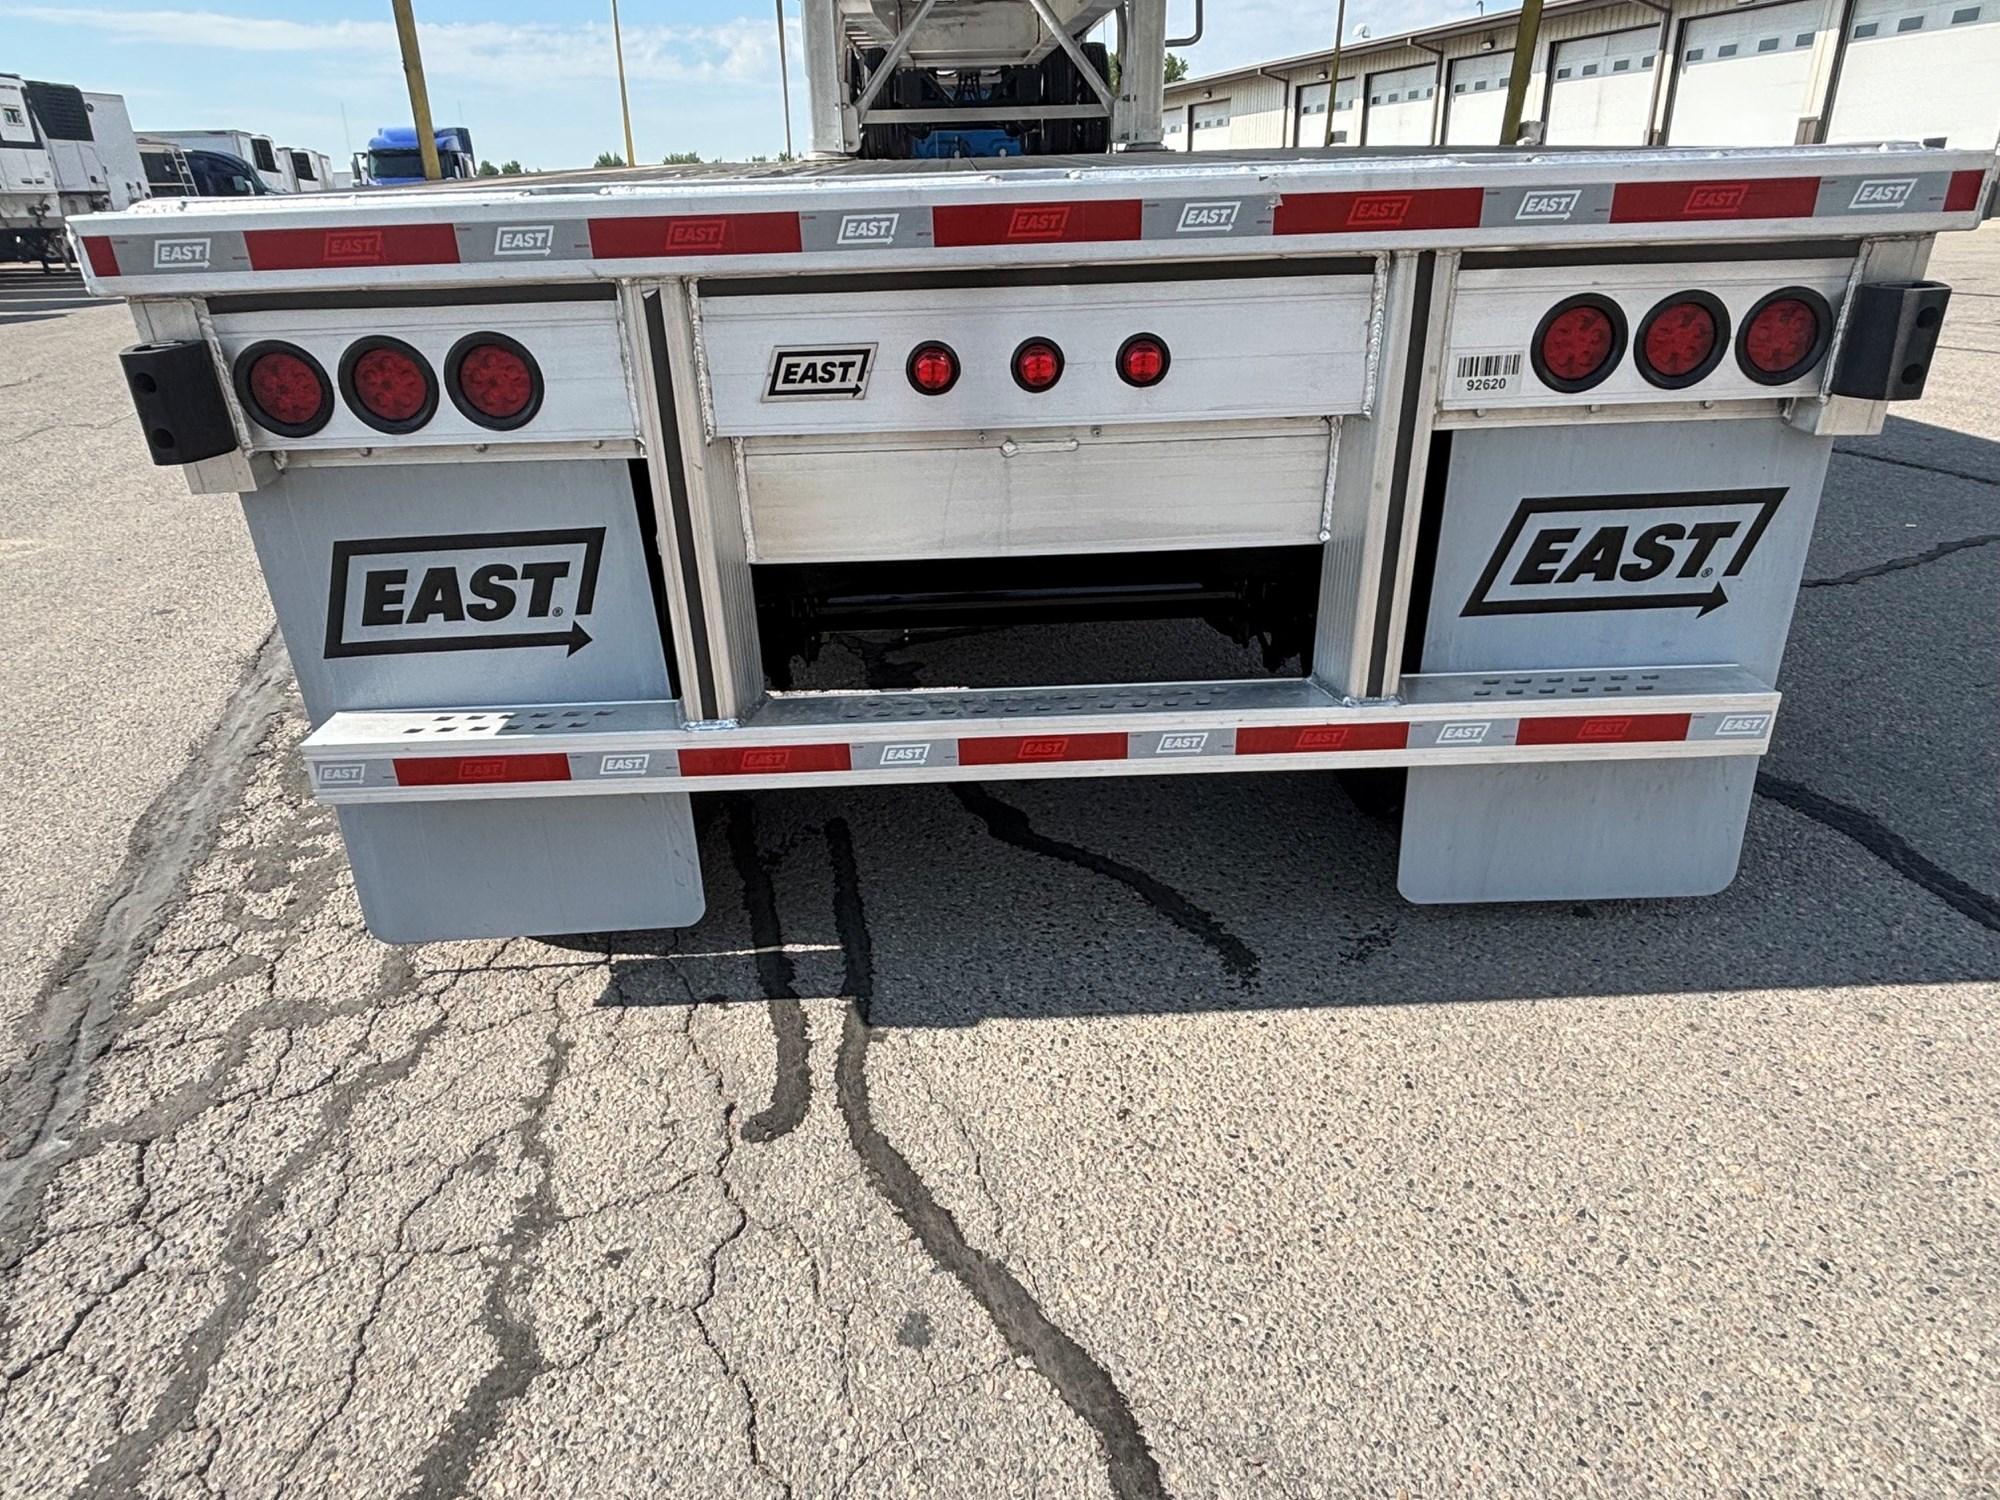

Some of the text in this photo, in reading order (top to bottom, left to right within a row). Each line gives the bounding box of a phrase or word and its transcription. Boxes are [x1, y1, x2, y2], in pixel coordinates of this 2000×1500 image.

[1860, 186, 1906, 200] EAST
[1526, 197, 1572, 212] EAST
[1186, 209, 1231, 224] EAST
[845, 222, 889, 236] EAST
[502, 232, 546, 247] EAST
[161, 246, 203, 260] EAST
[782, 362, 856, 384] EAST
[1467, 378, 1506, 391] 92620
[1723, 720, 1760, 730] EAST
[1443, 728, 1481, 738] EAST
[1164, 738, 1199, 748] EAST
[887, 749, 924, 759] EAST
[606, 759, 642, 770] EAST
[323, 769, 359, 779] EAST
